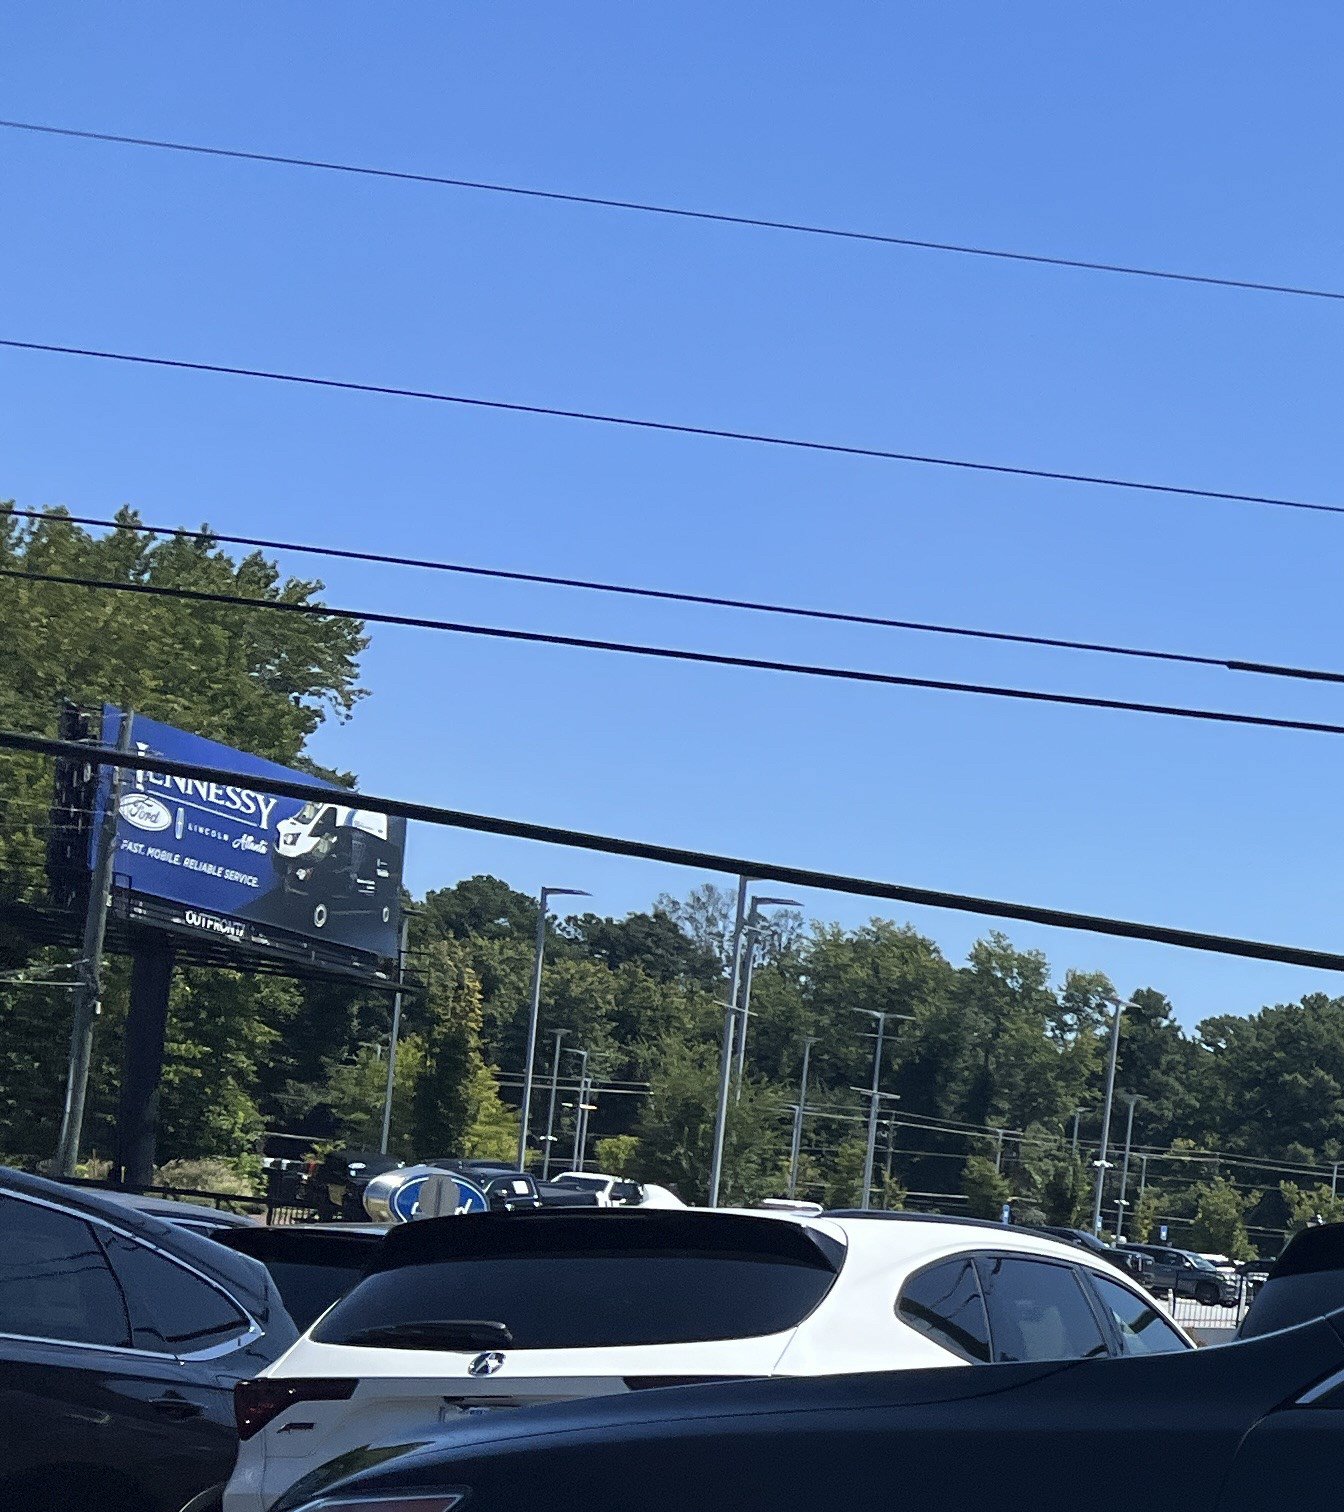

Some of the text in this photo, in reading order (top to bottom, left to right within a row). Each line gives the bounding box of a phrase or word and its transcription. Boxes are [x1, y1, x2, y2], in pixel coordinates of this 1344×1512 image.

[187, 822, 230, 842] LINCOLN
[232, 833, 269, 855] Atlanta
[120, 839, 146, 856] FAST.
[146, 846, 181, 866] MOBILE.
[182, 857, 225, 878] RELIABLE
